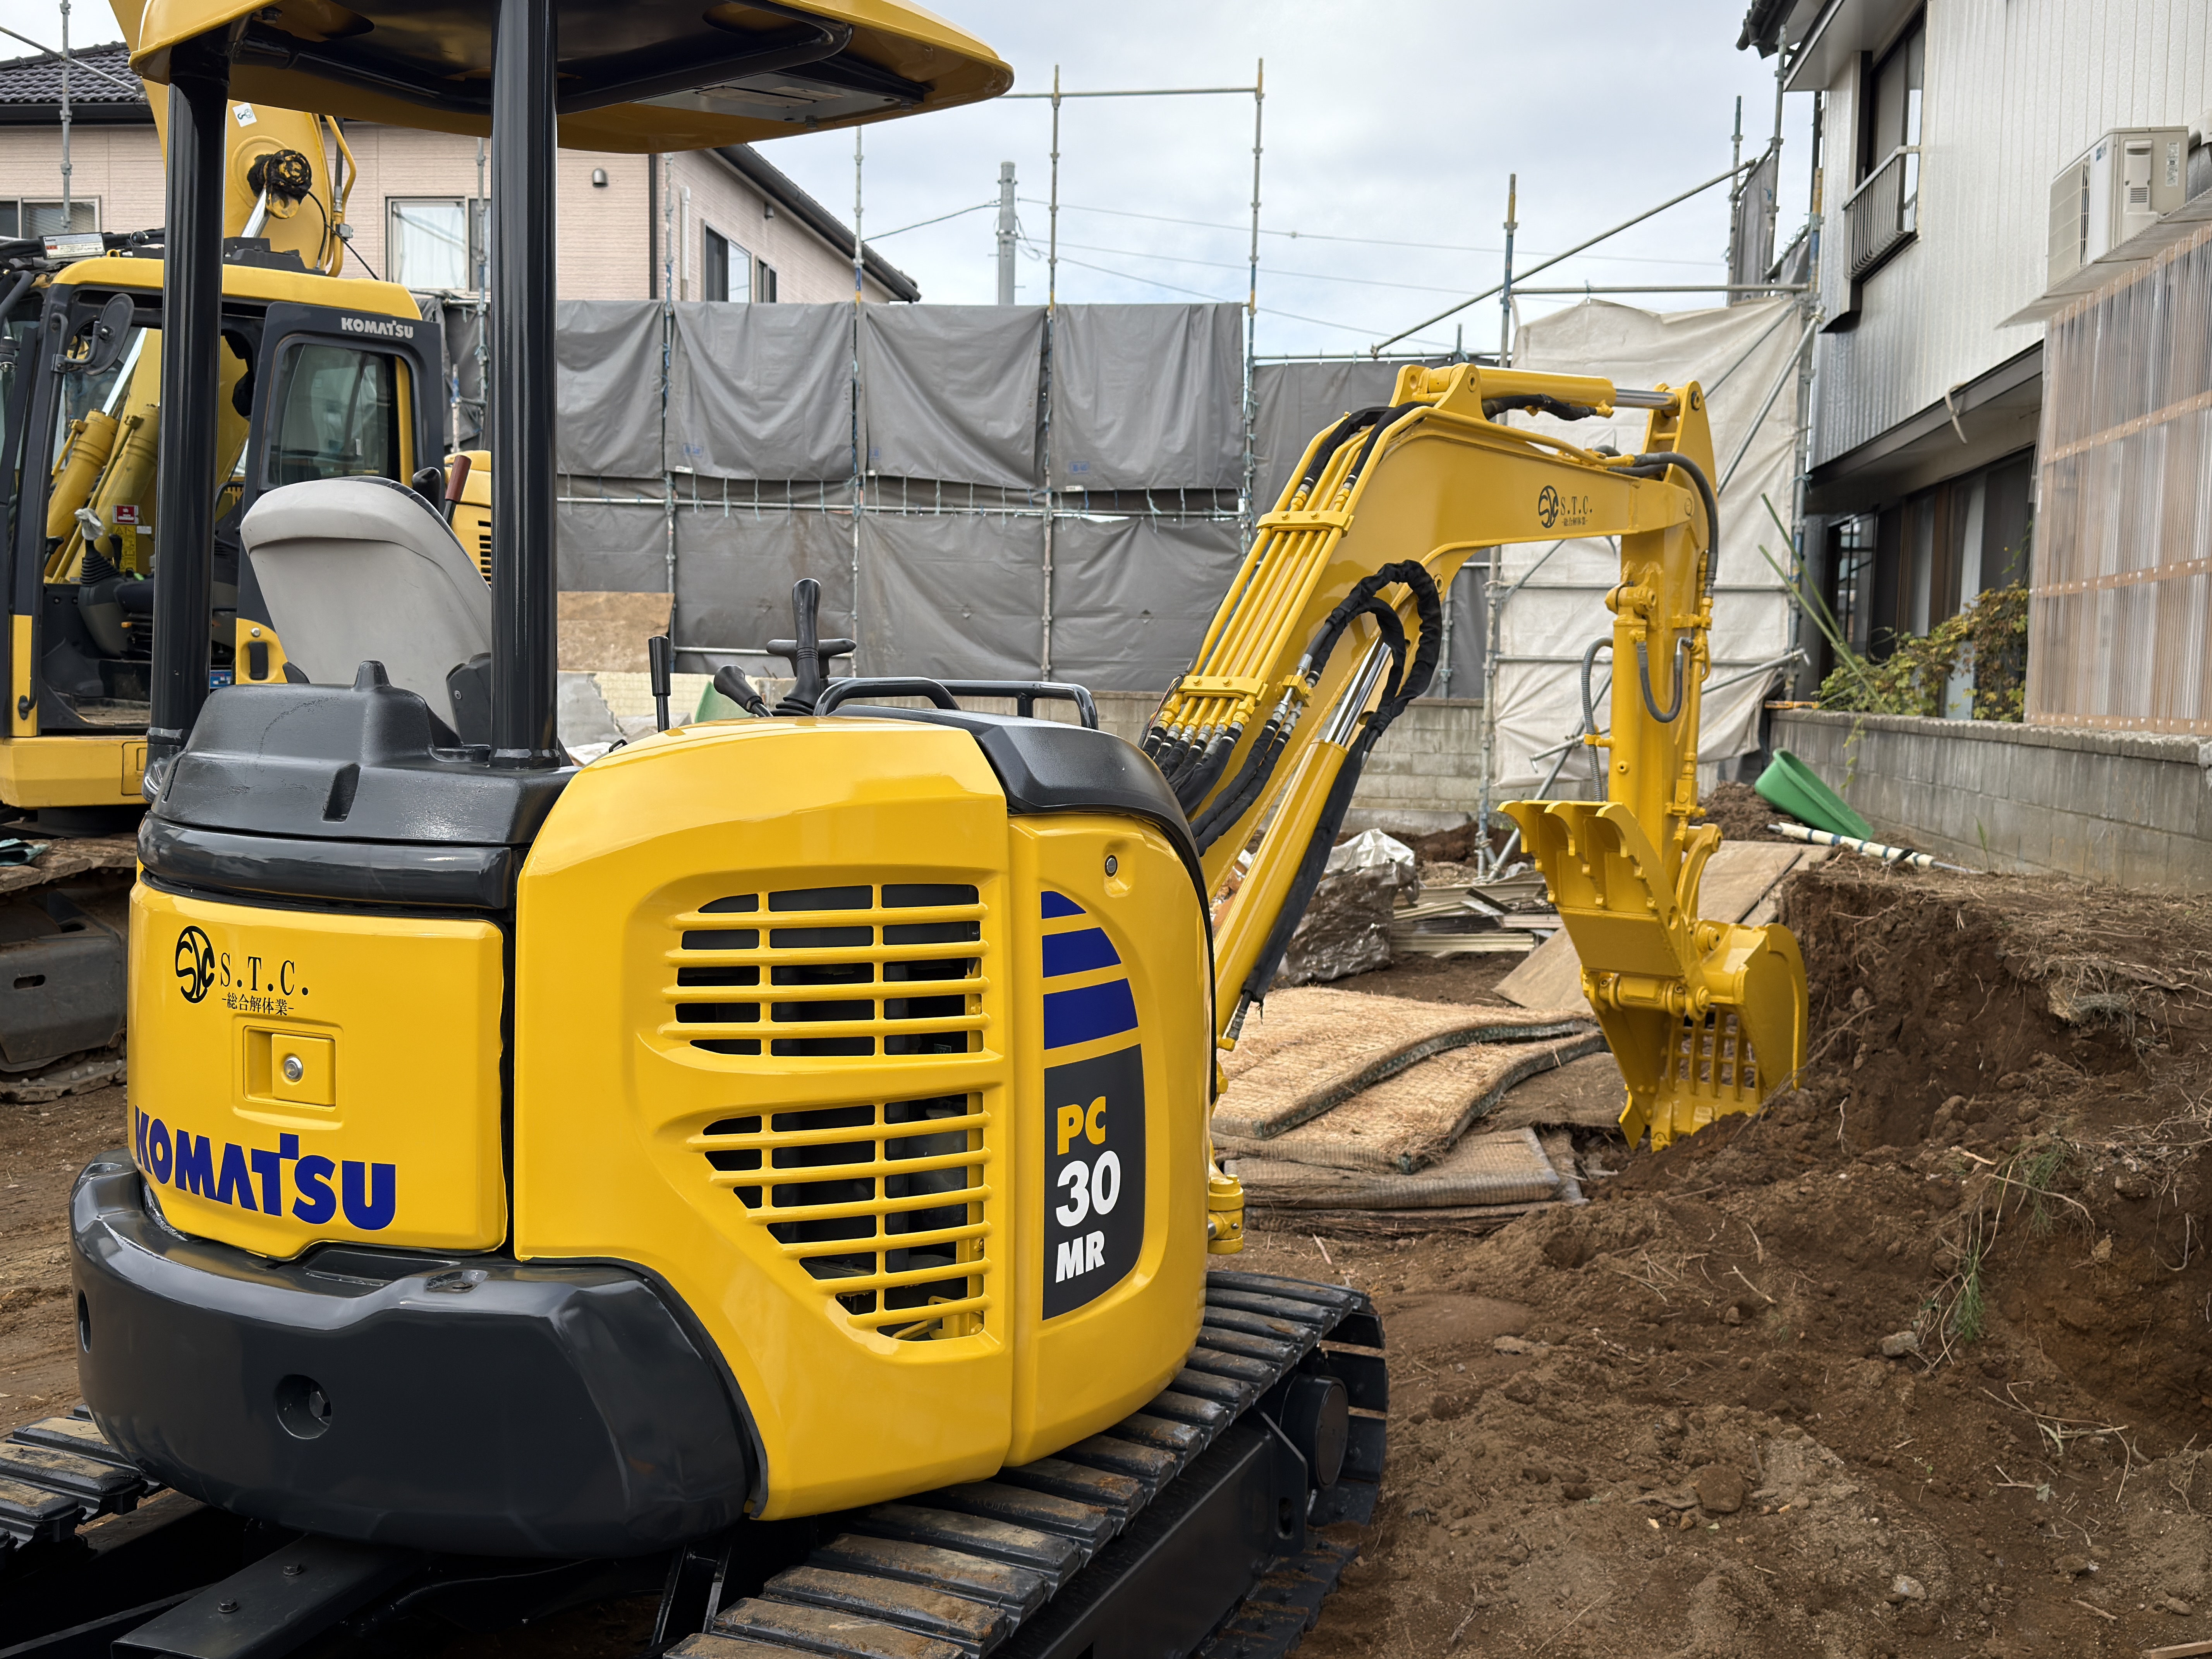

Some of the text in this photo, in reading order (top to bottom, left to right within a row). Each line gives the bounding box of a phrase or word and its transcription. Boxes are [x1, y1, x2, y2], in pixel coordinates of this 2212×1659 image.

[341, 317, 414, 338] KOMATSU
[1561, 495, 1592, 515] S.T.C.
[220, 952, 309, 996] S.T.C.
[1057, 1096, 1106, 1155] PC
[135, 1104, 395, 1230] KOMATSU
[1056, 1151, 1121, 1227] 30
[1056, 1231, 1105, 1283] MR
